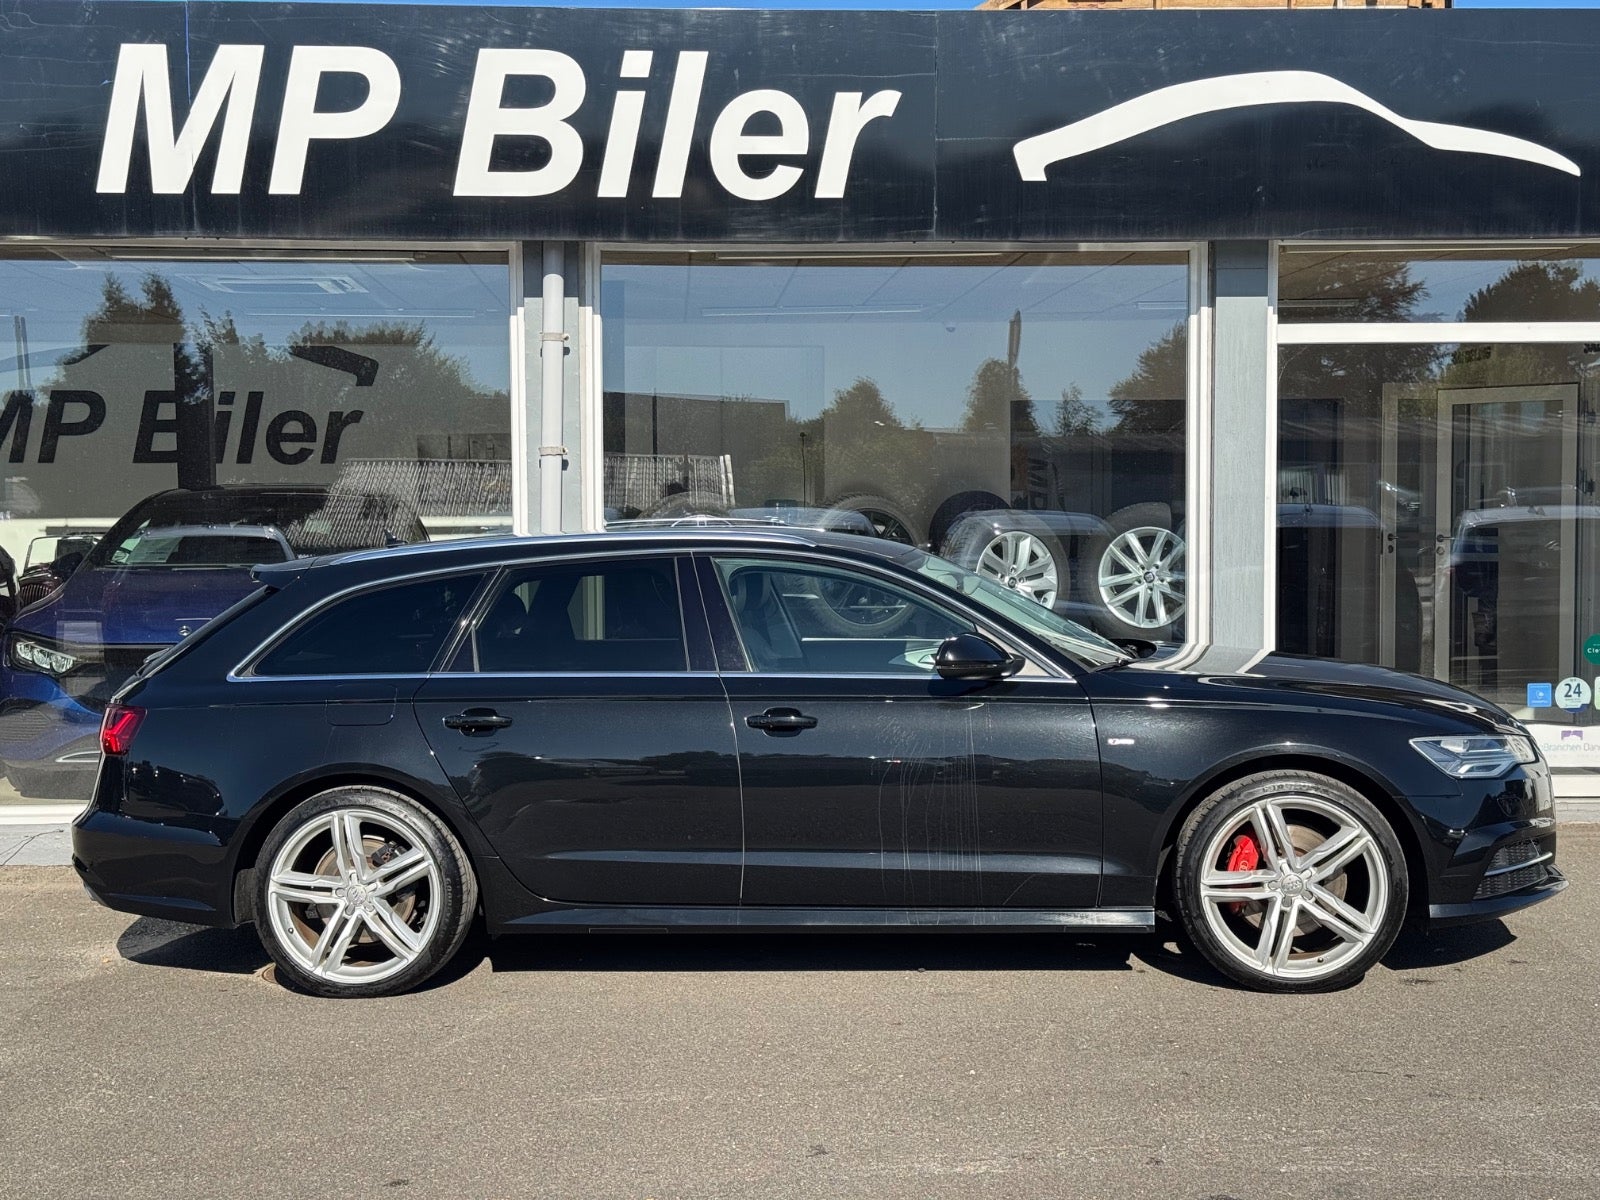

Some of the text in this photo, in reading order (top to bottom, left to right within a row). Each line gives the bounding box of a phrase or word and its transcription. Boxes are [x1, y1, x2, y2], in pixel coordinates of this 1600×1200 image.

[96, 44, 901, 200] MP Biler
[133, 390, 364, 464] Biler
[1564, 683, 1582, 698] 24
